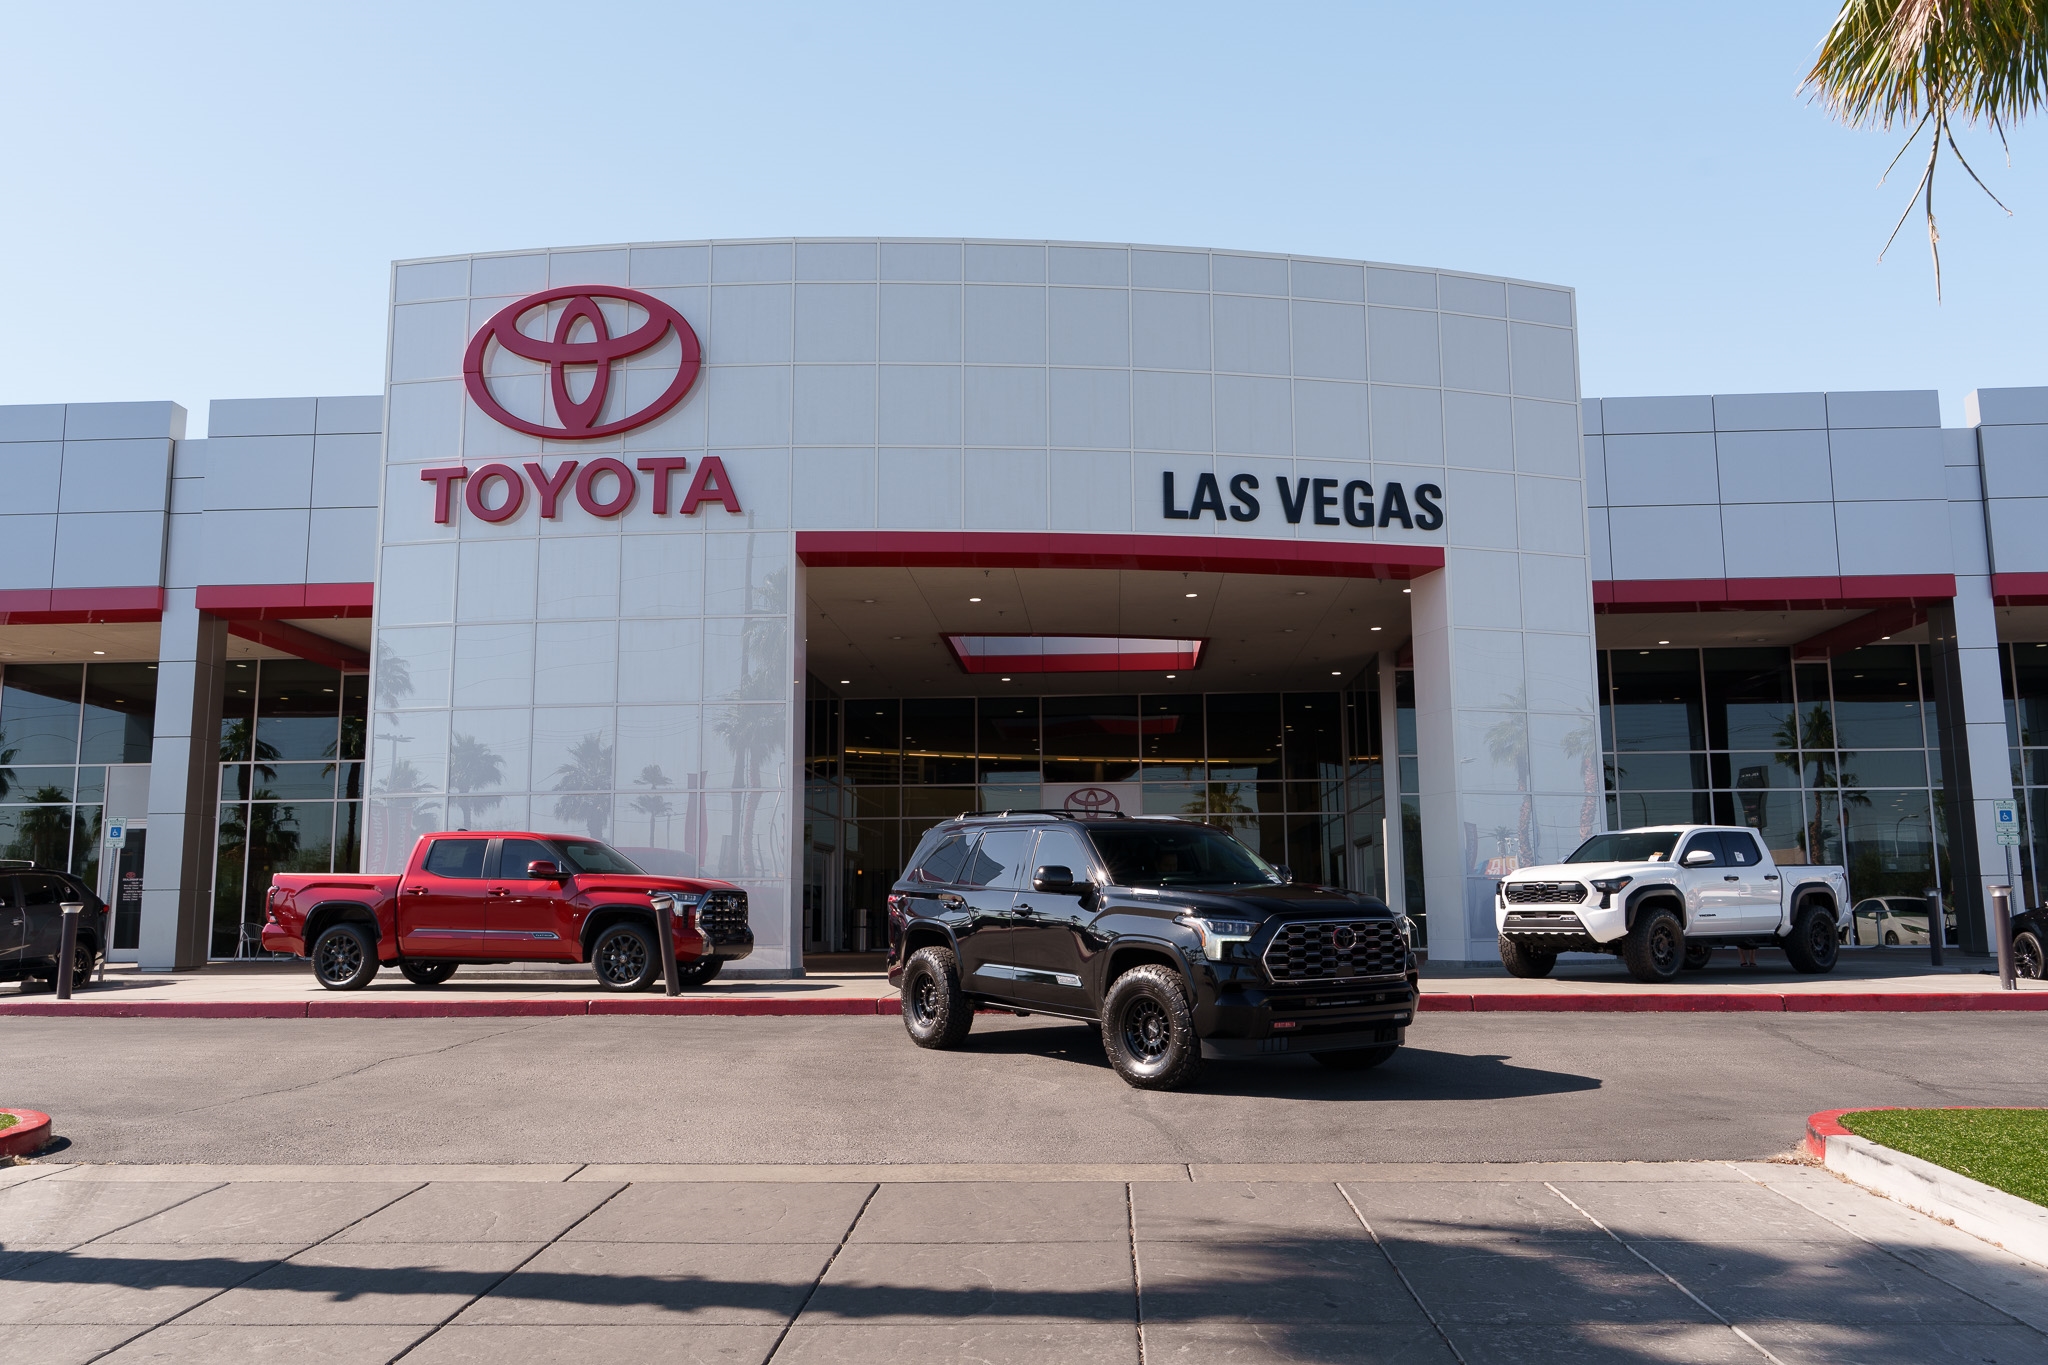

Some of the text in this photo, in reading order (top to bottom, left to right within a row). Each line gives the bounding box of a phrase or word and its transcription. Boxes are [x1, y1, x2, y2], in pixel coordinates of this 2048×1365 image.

[421, 456, 741, 523] TOYOTA
[1163, 471, 1444, 531] LAS VEGAS
